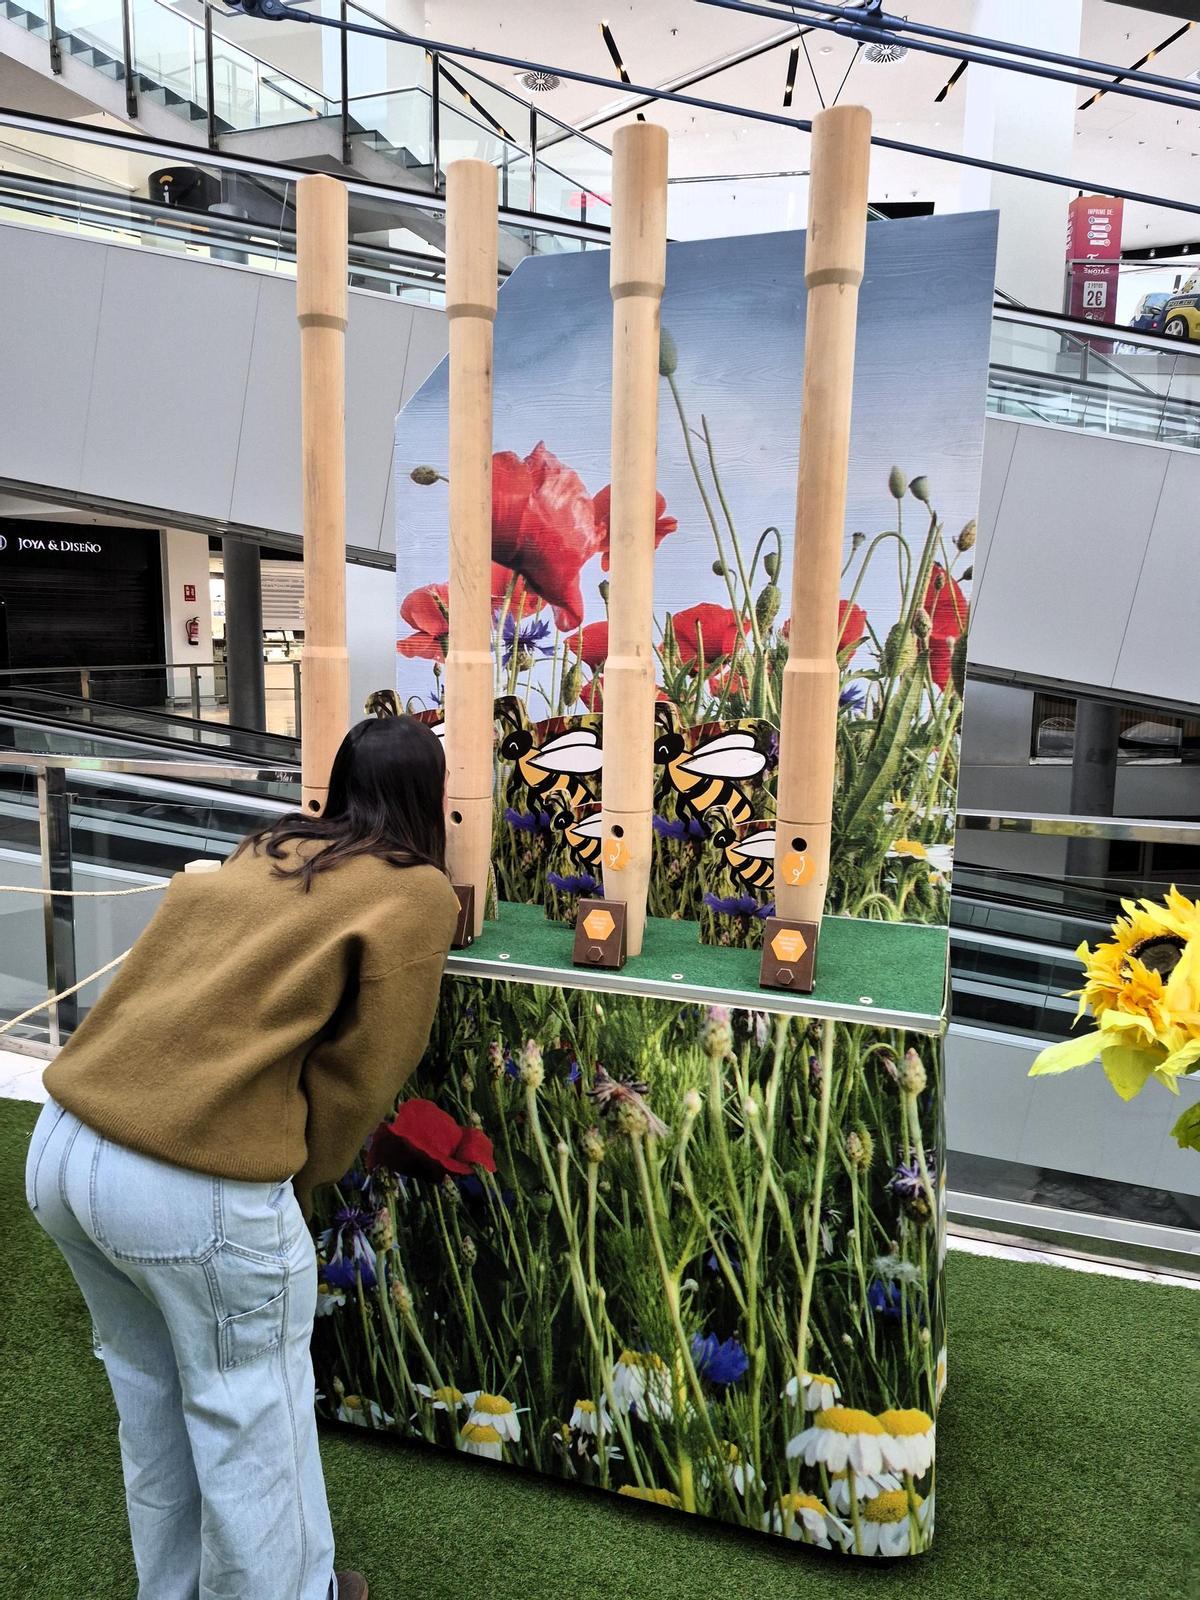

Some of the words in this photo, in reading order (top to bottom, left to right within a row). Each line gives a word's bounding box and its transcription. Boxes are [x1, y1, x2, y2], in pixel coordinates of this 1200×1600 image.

[1086, 290, 1103, 306] 2€
[18, 537, 46, 551] JOYA
[48, 540, 59, 551] &
[60, 540, 102, 553] DISEÑO
